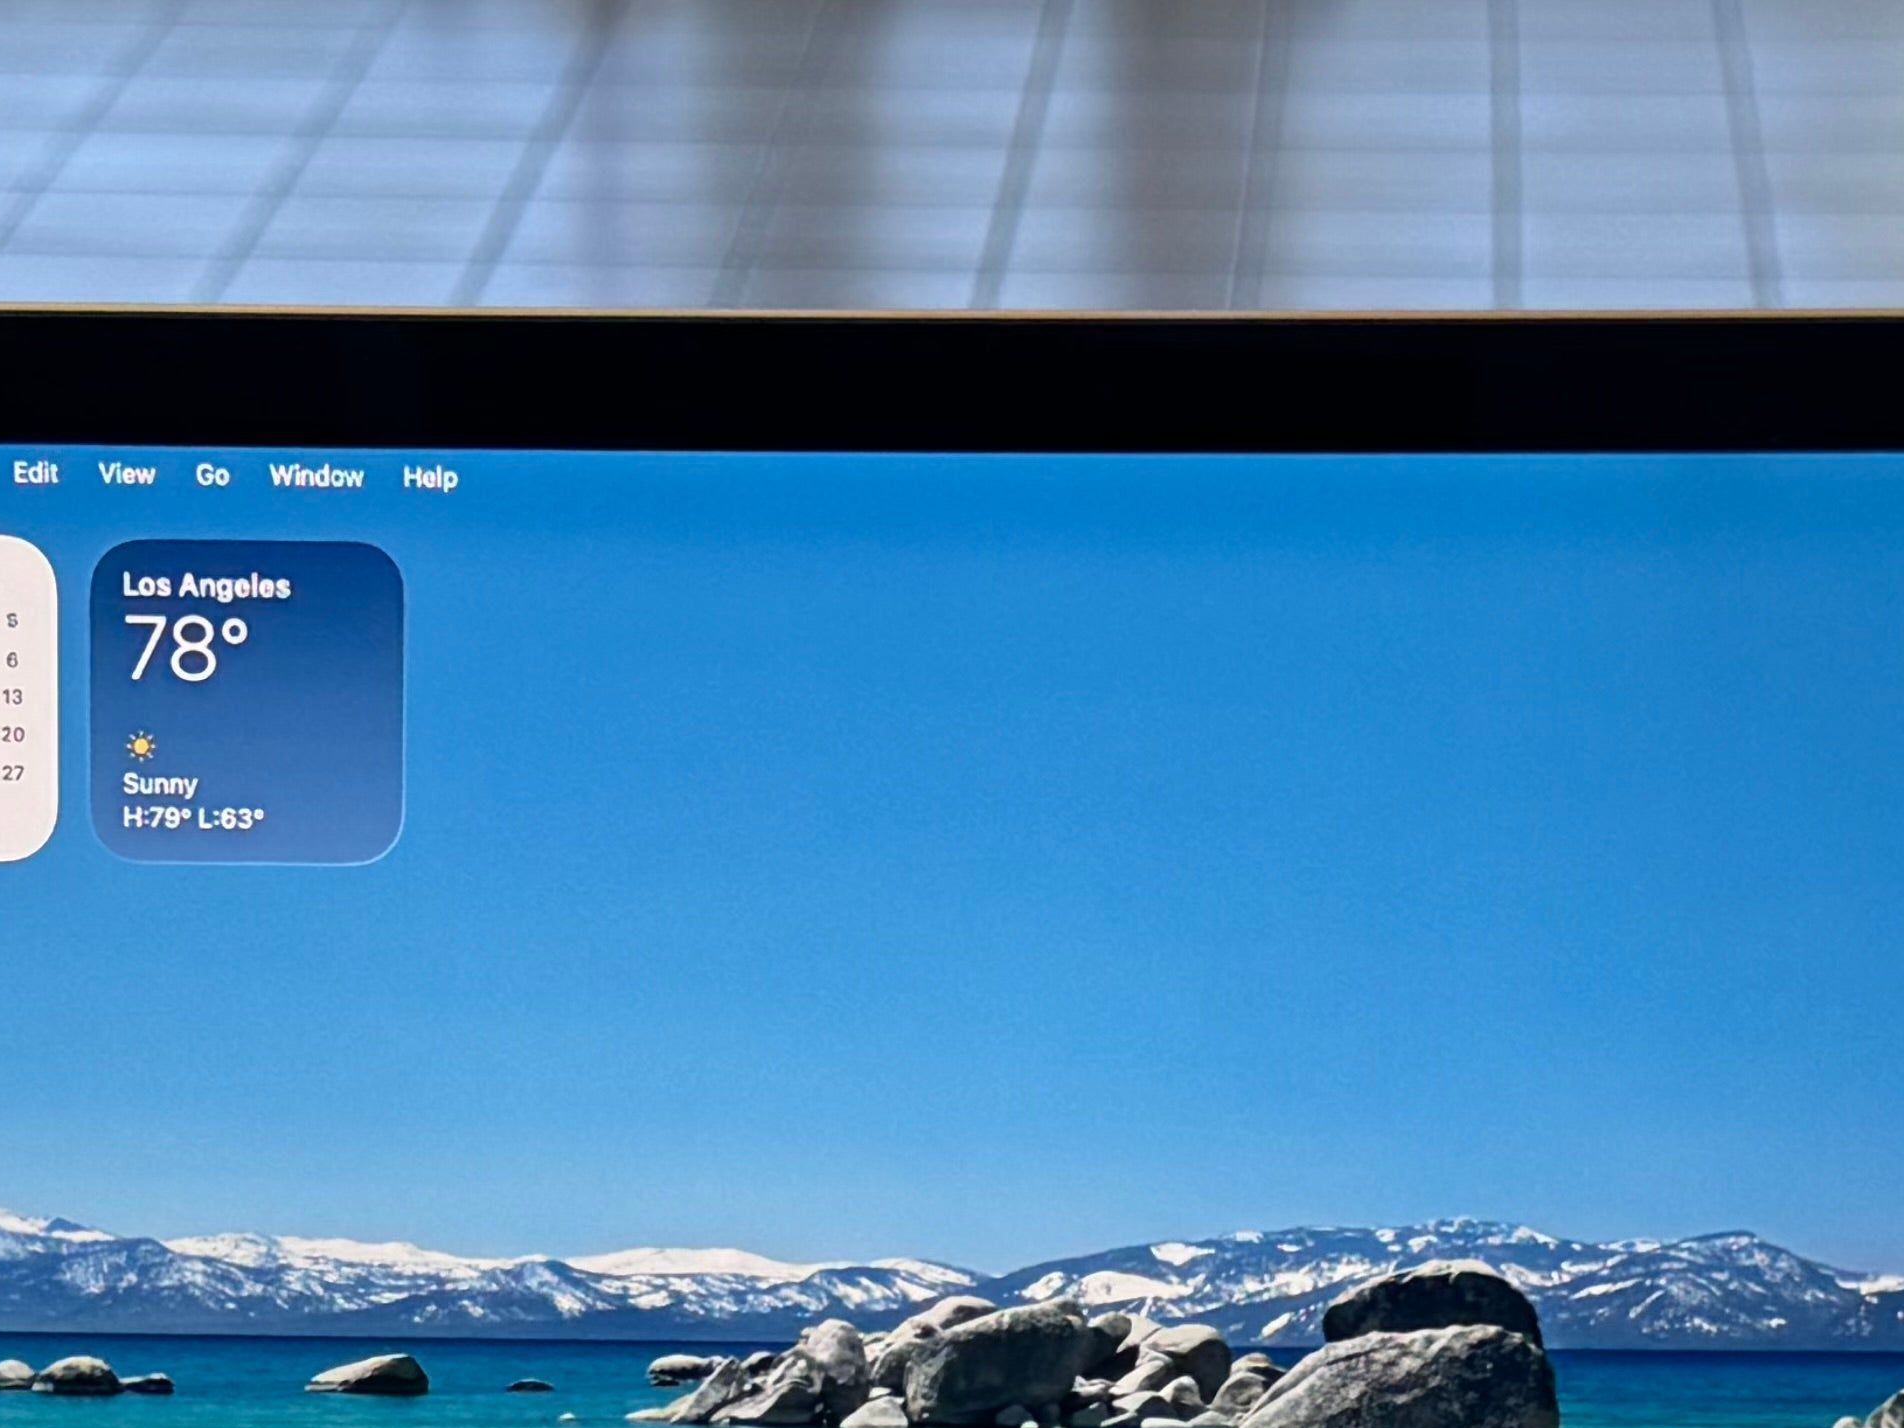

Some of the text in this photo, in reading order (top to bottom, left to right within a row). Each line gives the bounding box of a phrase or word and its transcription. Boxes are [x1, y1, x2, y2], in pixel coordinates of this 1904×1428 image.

[13, 460, 59, 484] Edit
[98, 461, 156, 485] View
[196, 463, 230, 487] Go
[269, 463, 365, 488] Window
[403, 464, 459, 493] Help
[123, 571, 292, 603] Los Angeles
[6, 612, 19, 629] S
[124, 614, 248, 682] 78°
[6, 651, 19, 669] 6
[2, 688, 23, 706] 13
[1, 725, 26, 743] 20
[2, 764, 25, 781] 27
[123, 772, 199, 800] Sunny
[123, 805, 265, 830] H:79° L:63°
